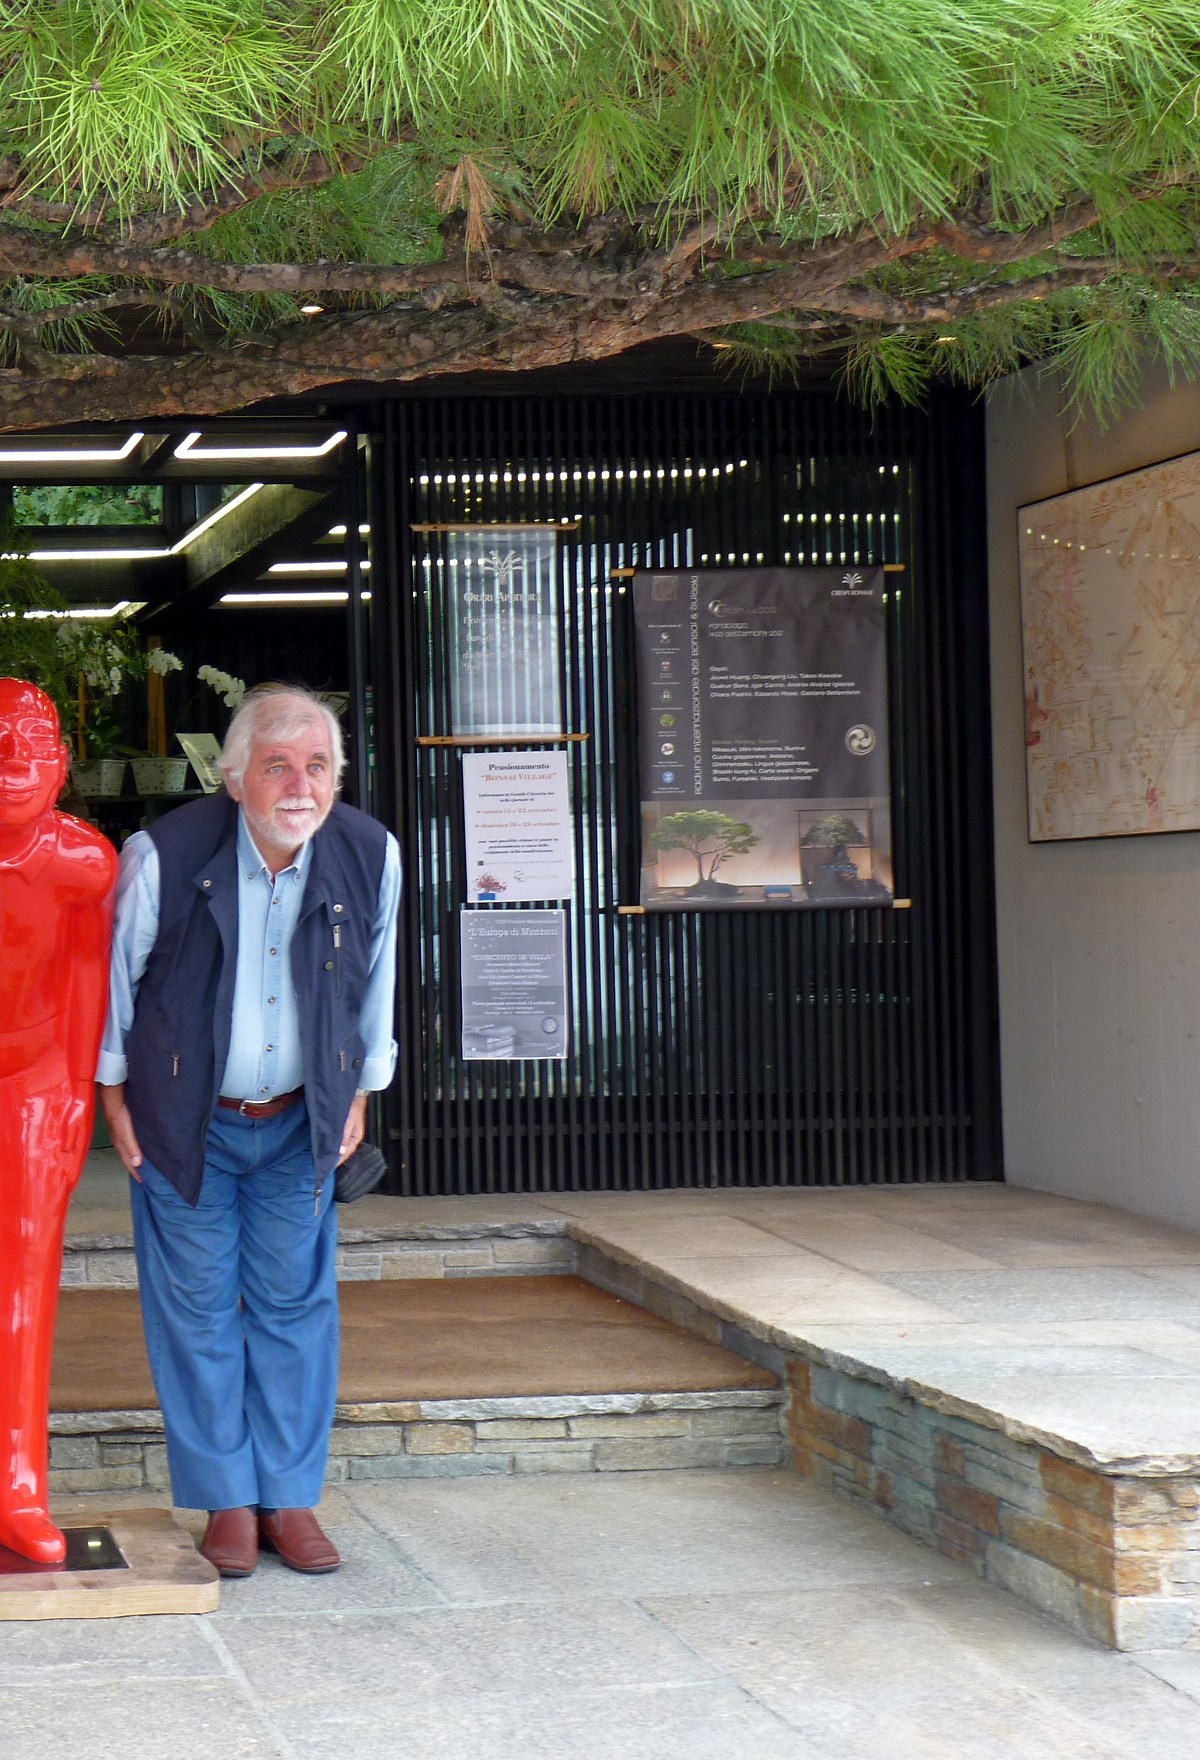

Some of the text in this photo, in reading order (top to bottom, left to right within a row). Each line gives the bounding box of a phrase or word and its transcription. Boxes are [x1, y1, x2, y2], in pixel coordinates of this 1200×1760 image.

[488, 763, 550, 771] Pensionamento
[510, 928, 519, 936] di
[521, 928, 557, 936] Manzoni
